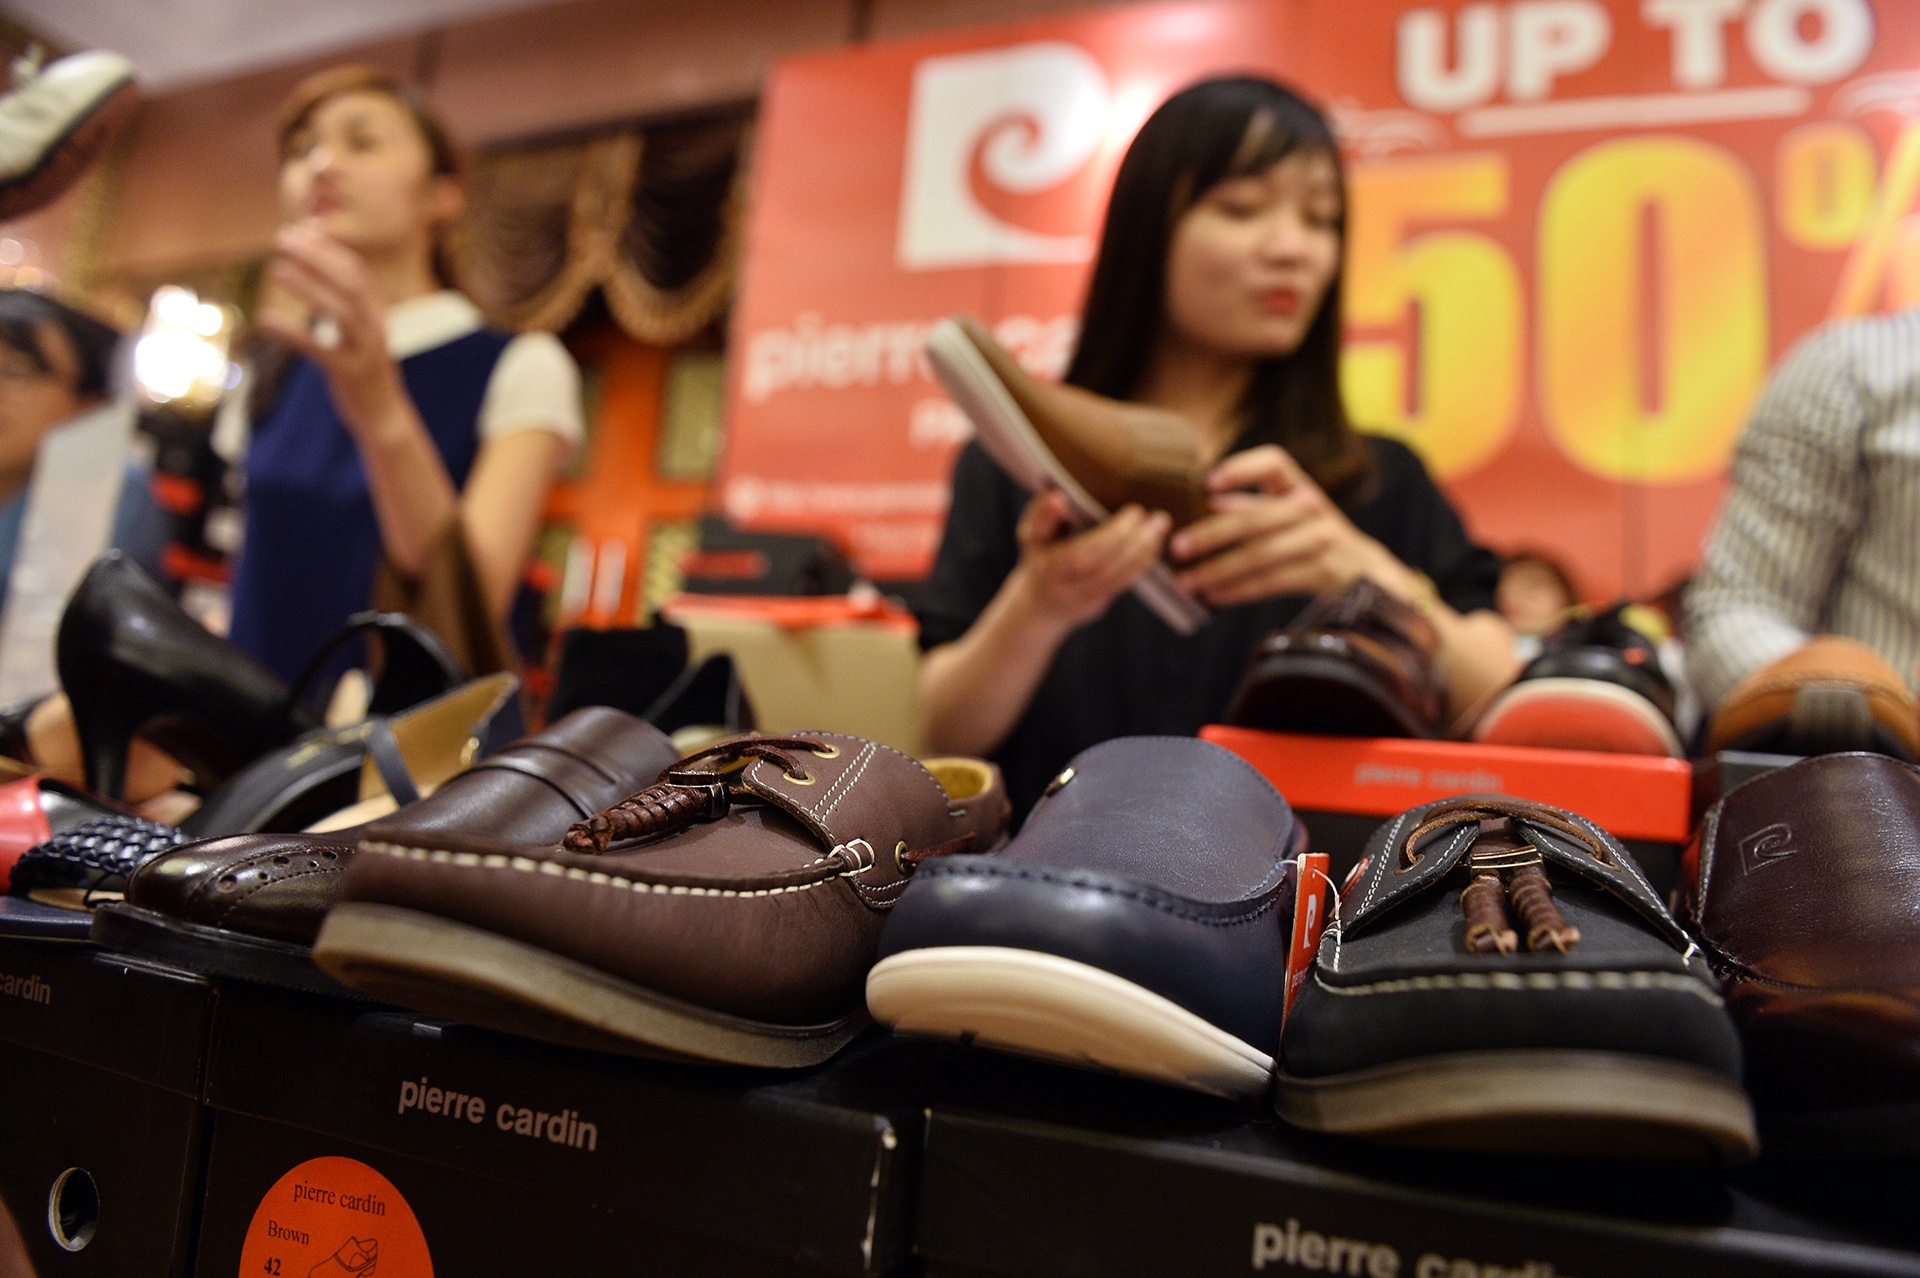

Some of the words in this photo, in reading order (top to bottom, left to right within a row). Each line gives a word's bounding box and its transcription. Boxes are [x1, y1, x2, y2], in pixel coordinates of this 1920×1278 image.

[1398, 4, 1612, 112] UP
[1642, 0, 1878, 91] TO
[398, 1077, 486, 1125] pierre
[496, 1103, 598, 1151] cardin
[293, 1180, 336, 1206] pierre
[339, 1193, 386, 1217] cardin
[267, 1219, 310, 1246] Brown
[1252, 1217, 1401, 1278] pierre
[263, 1256, 282, 1277] 42
